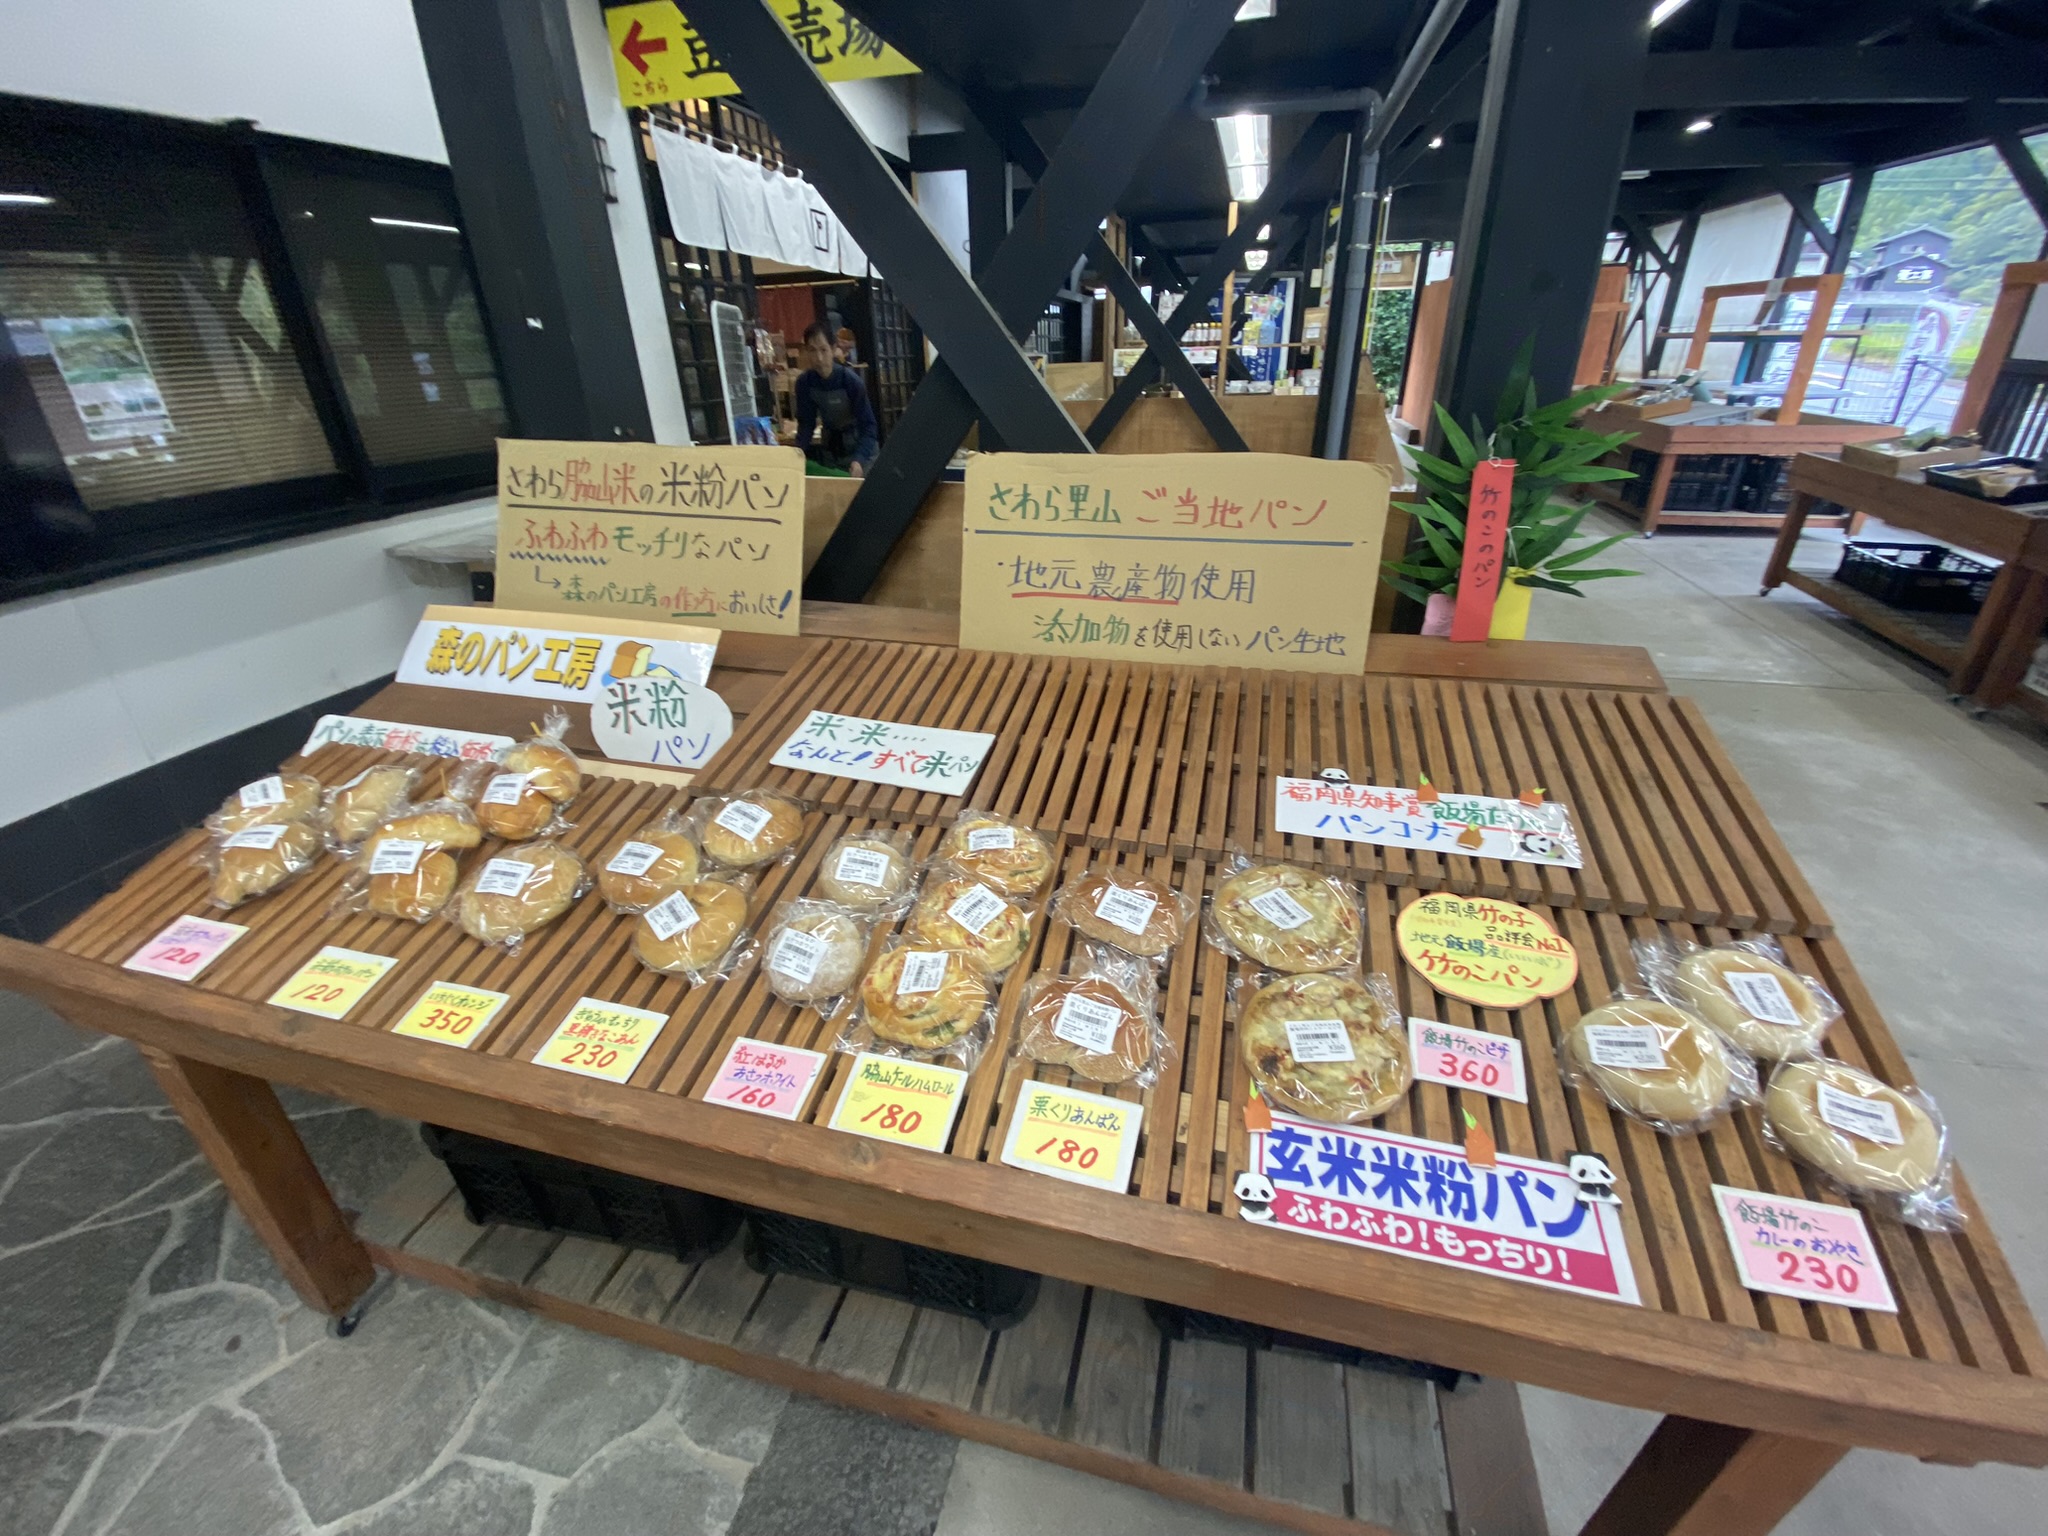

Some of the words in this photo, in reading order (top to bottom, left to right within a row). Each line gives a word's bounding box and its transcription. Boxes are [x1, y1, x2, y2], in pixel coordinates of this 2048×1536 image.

[632, 77, 669, 97] こちら
[990, 482, 1121, 525] さわら里山
[1136, 486, 1328, 529] ご当地パン
[515, 518, 771, 562] ふわふわモッチリなパン
[1032, 607, 1347, 657] 添加物を使用しないパン生地
[425, 625, 603, 690] 森のパン工房
[607, 680, 690, 735] 米粉
[652, 732, 711, 765] パン
[148, 946, 202, 965] 120
[288, 983, 345, 1003] 120
[418, 1007, 474, 1035] 350
[560, 1041, 619, 1069] 230
[1438, 1052, 1500, 1087] 360
[726, 1084, 777, 1109] 160
[1030, 1095, 1122, 1132] 栗くりあんぱん
[859, 1102, 923, 1135] 180
[1035, 1136, 1100, 1170] 180
[1265, 1125, 1587, 1239] 玄米米粉パン
[1776, 1250, 1860, 1294] 230
